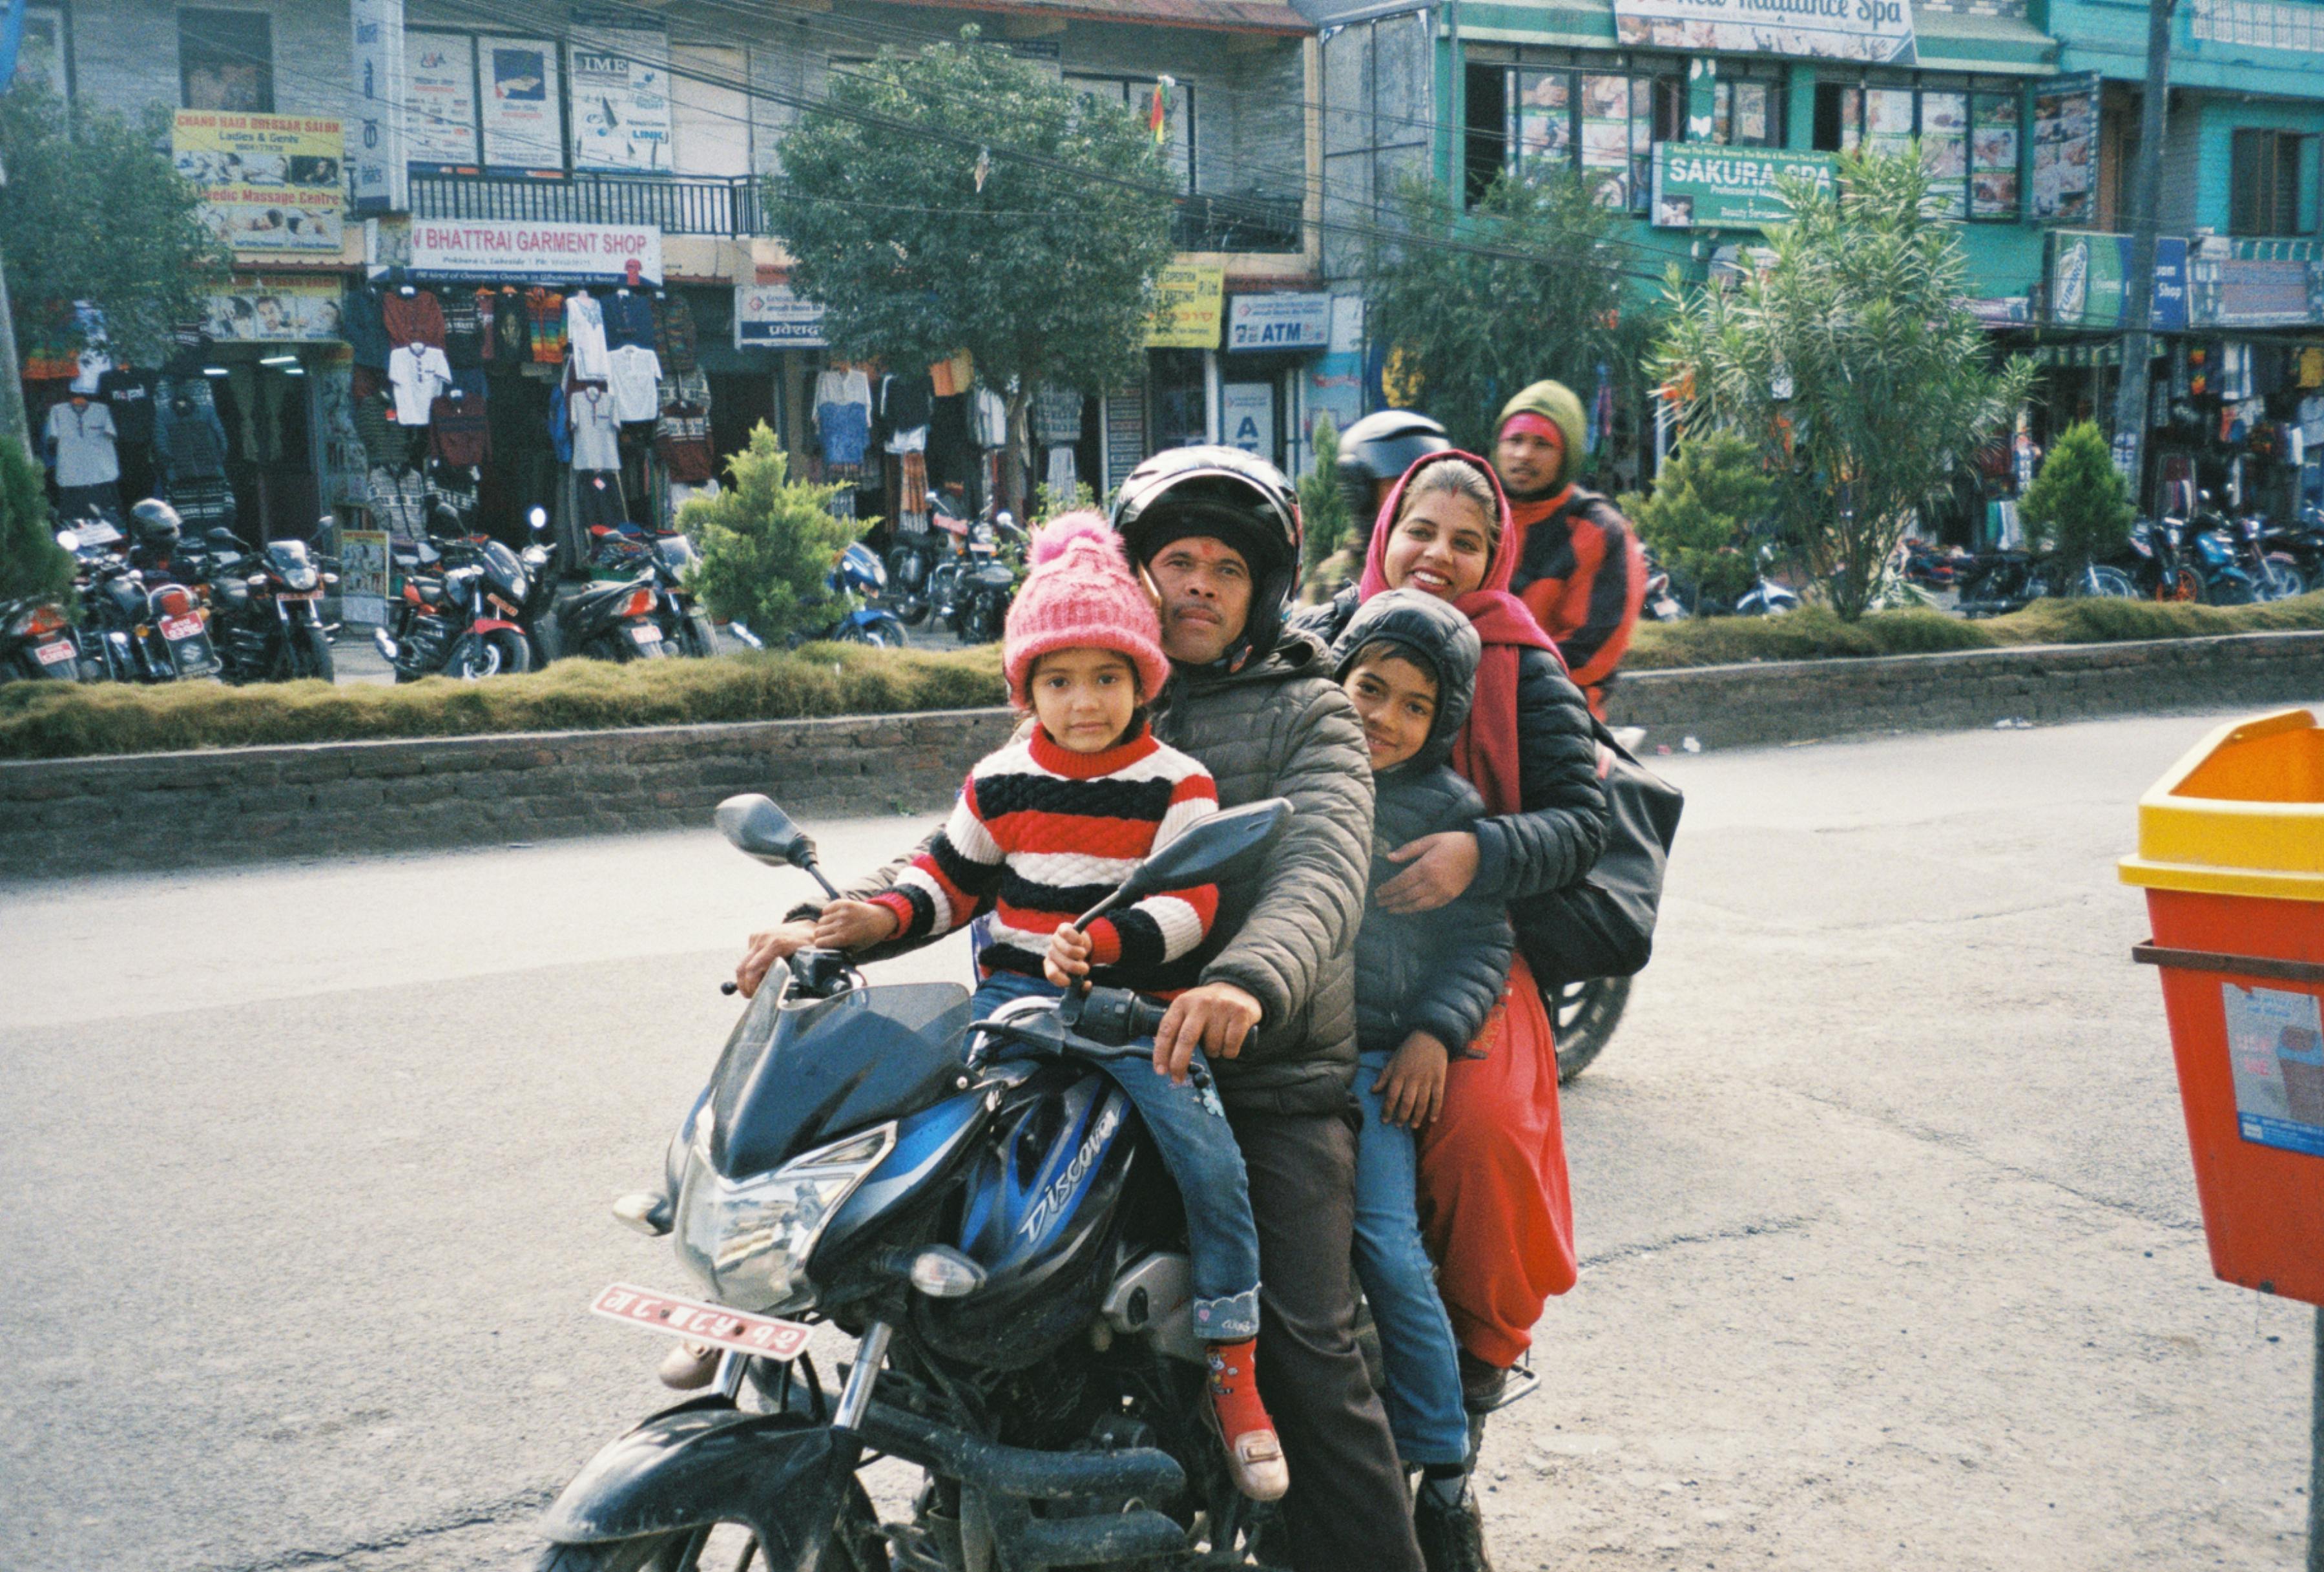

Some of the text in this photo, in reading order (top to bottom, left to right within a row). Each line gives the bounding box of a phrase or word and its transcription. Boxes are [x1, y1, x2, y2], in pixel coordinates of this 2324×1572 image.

[583, 56, 628, 71] IME
[304, 120, 340, 133] SALON
[632, 129, 662, 140] LINK
[218, 131, 254, 142] Ladies
[258, 132, 266, 143] &
[1669, 158, 1778, 186] SAKURA
[242, 189, 295, 205] Massage
[298, 192, 339, 205] Centre
[426, 228, 513, 251] BHATTRAI
[516, 231, 599, 253] GARMENT
[602, 233, 647, 255] SHOP
[1261, 323, 1302, 342] ATM
[1019, 1107, 1119, 1244] Discove
